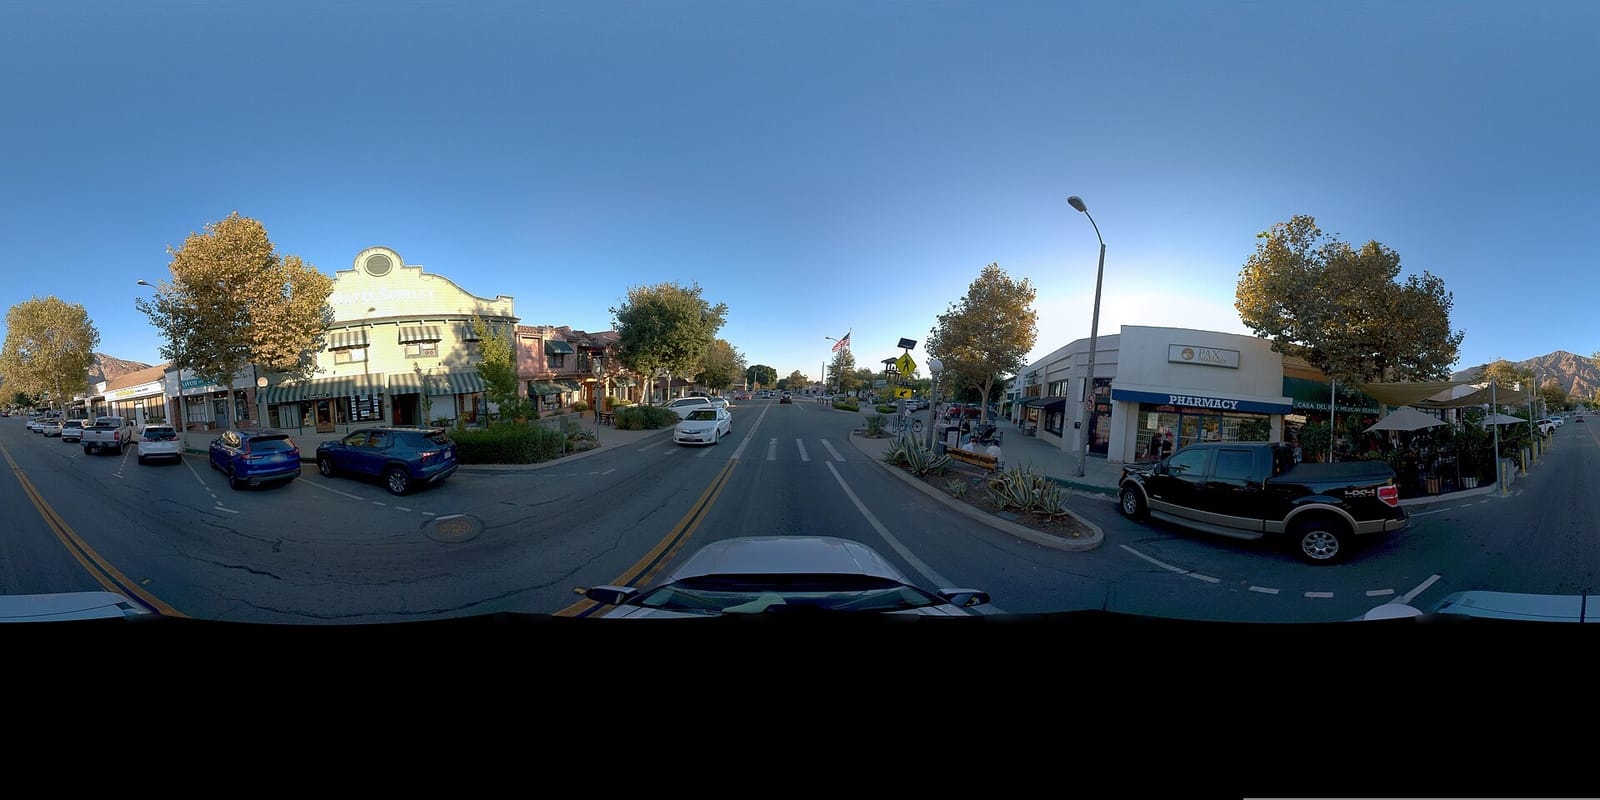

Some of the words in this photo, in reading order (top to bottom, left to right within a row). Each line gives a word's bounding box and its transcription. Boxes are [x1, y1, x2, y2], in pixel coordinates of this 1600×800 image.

[1198, 349, 1221, 360] PAX
[1168, 395, 1239, 410] PHARMACY
[1297, 401, 1315, 409] CASA
